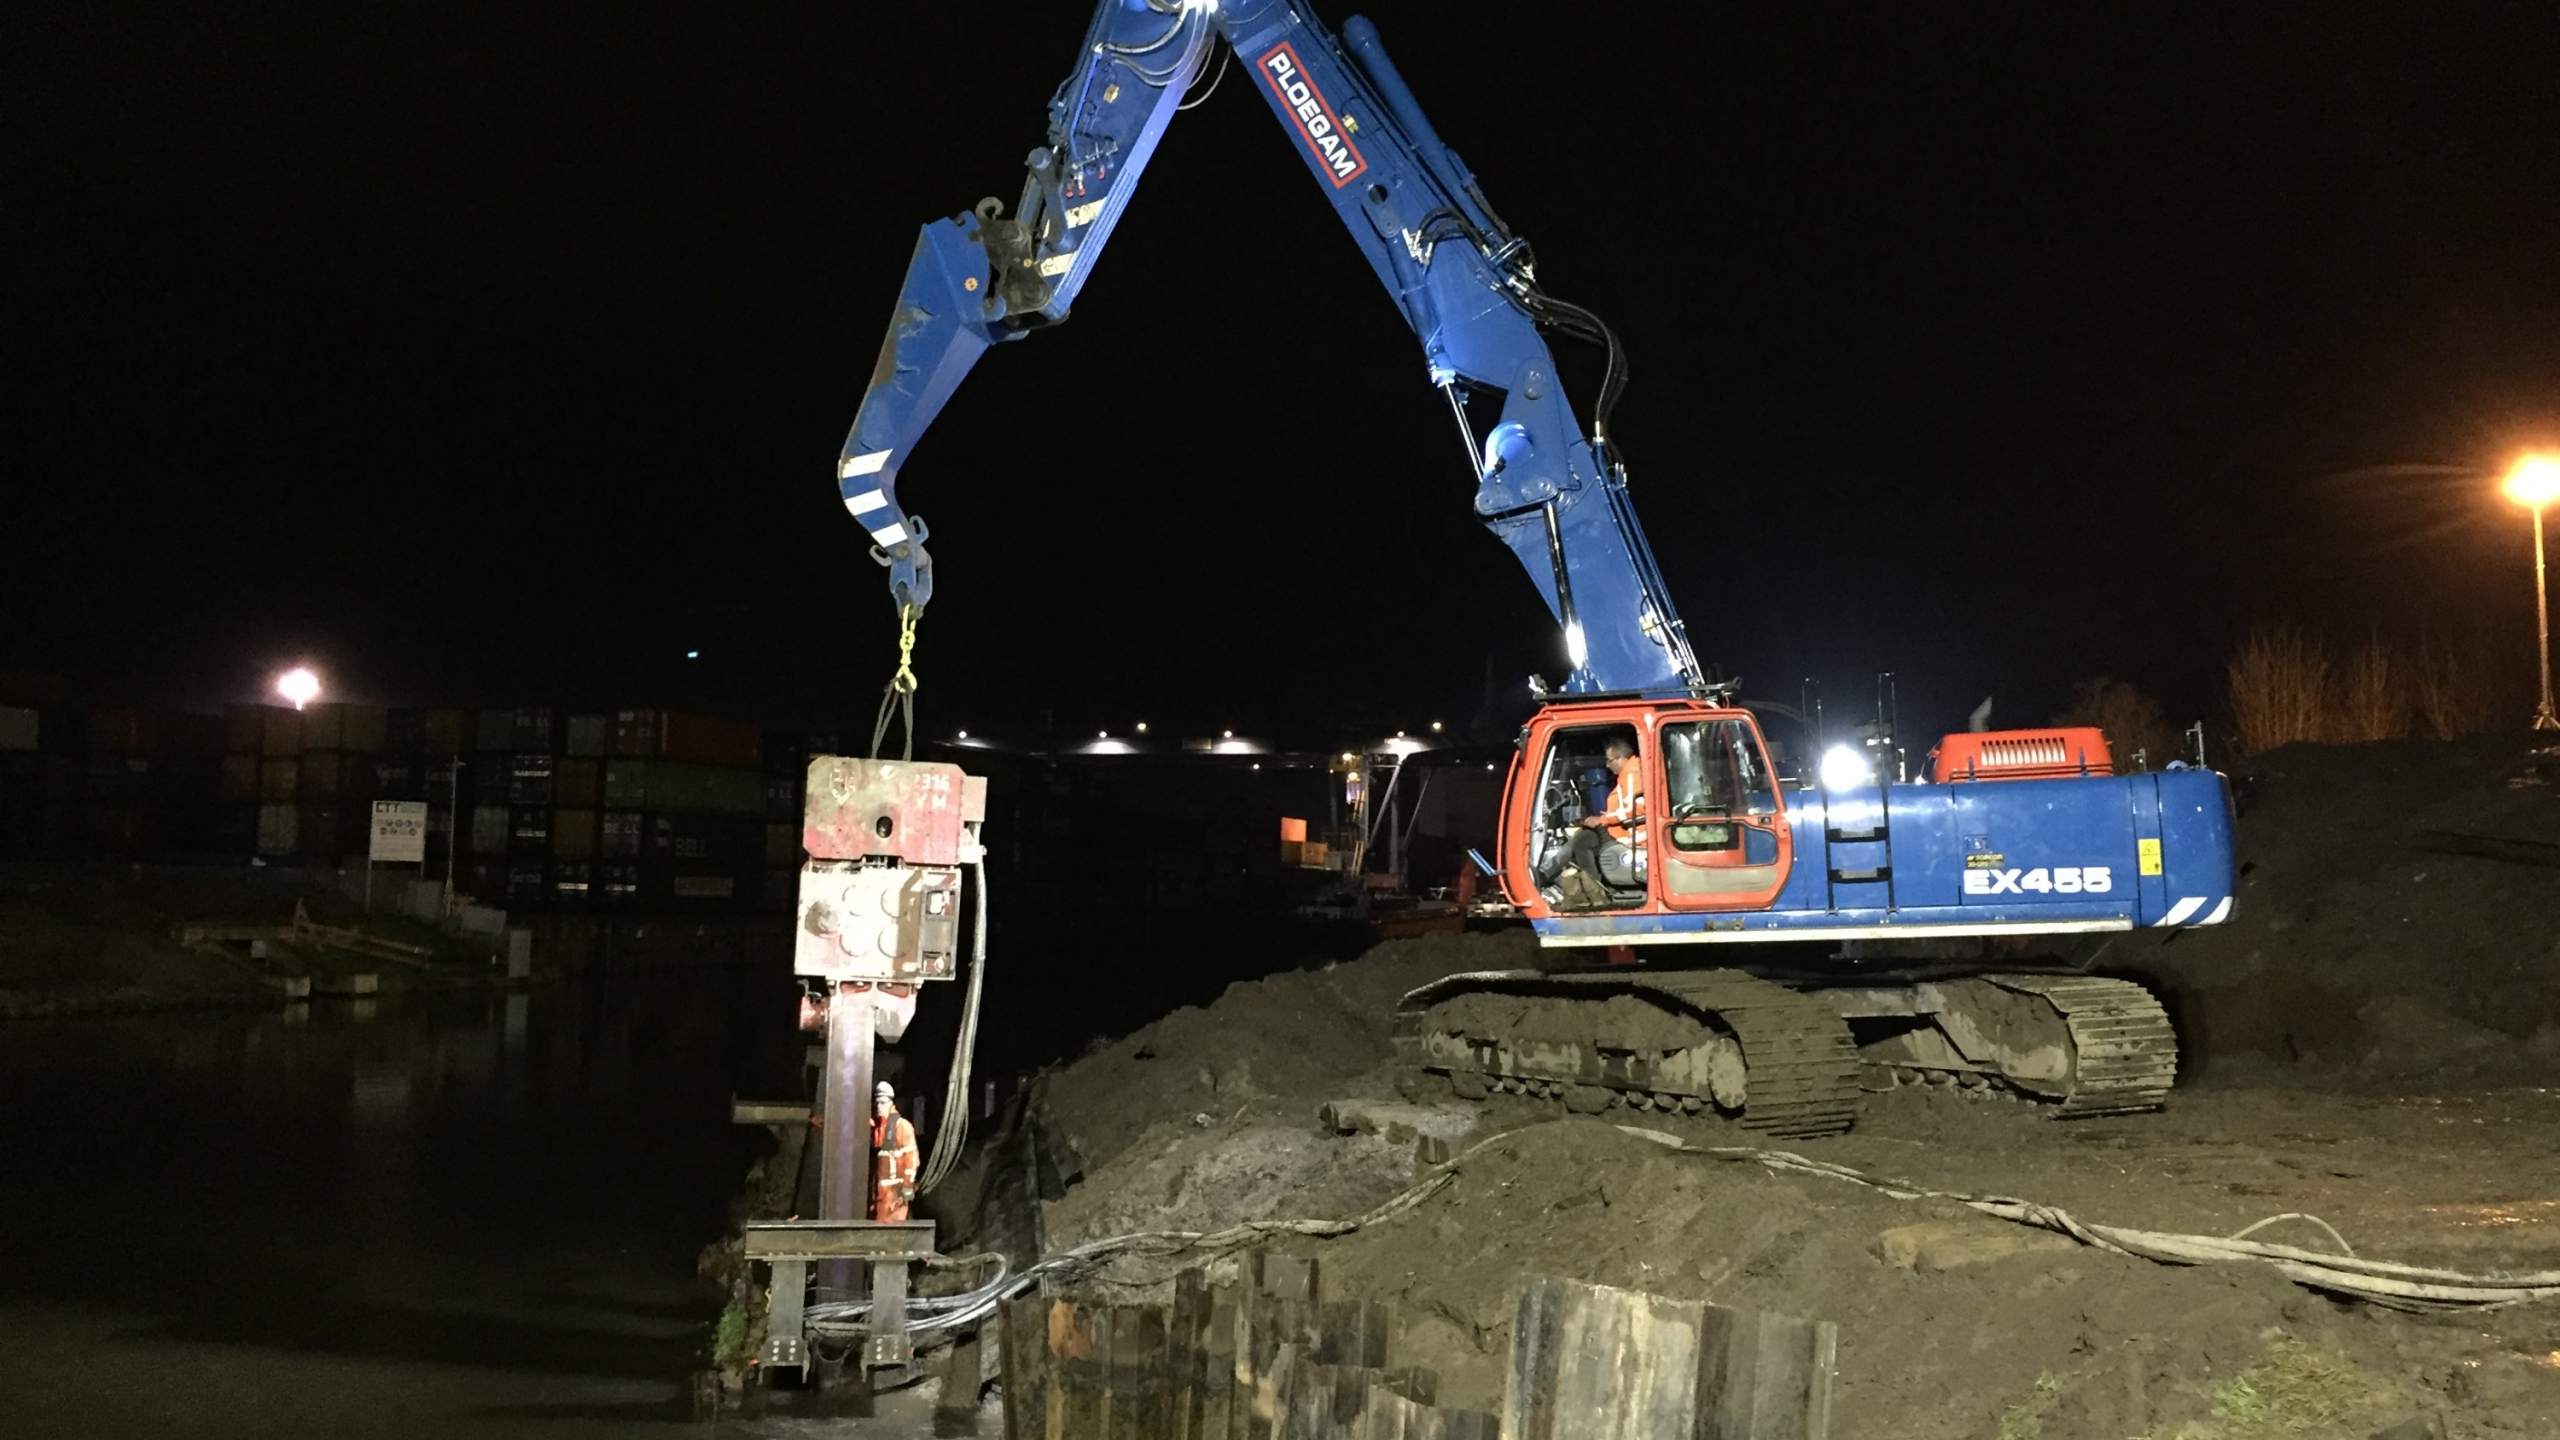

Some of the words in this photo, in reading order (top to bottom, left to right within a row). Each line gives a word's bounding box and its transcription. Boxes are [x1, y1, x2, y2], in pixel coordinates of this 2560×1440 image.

[1267, 52, 1357, 178] PLOEGAM
[375, 802, 401, 813] CTT
[1963, 866, 2112, 895] EX455
